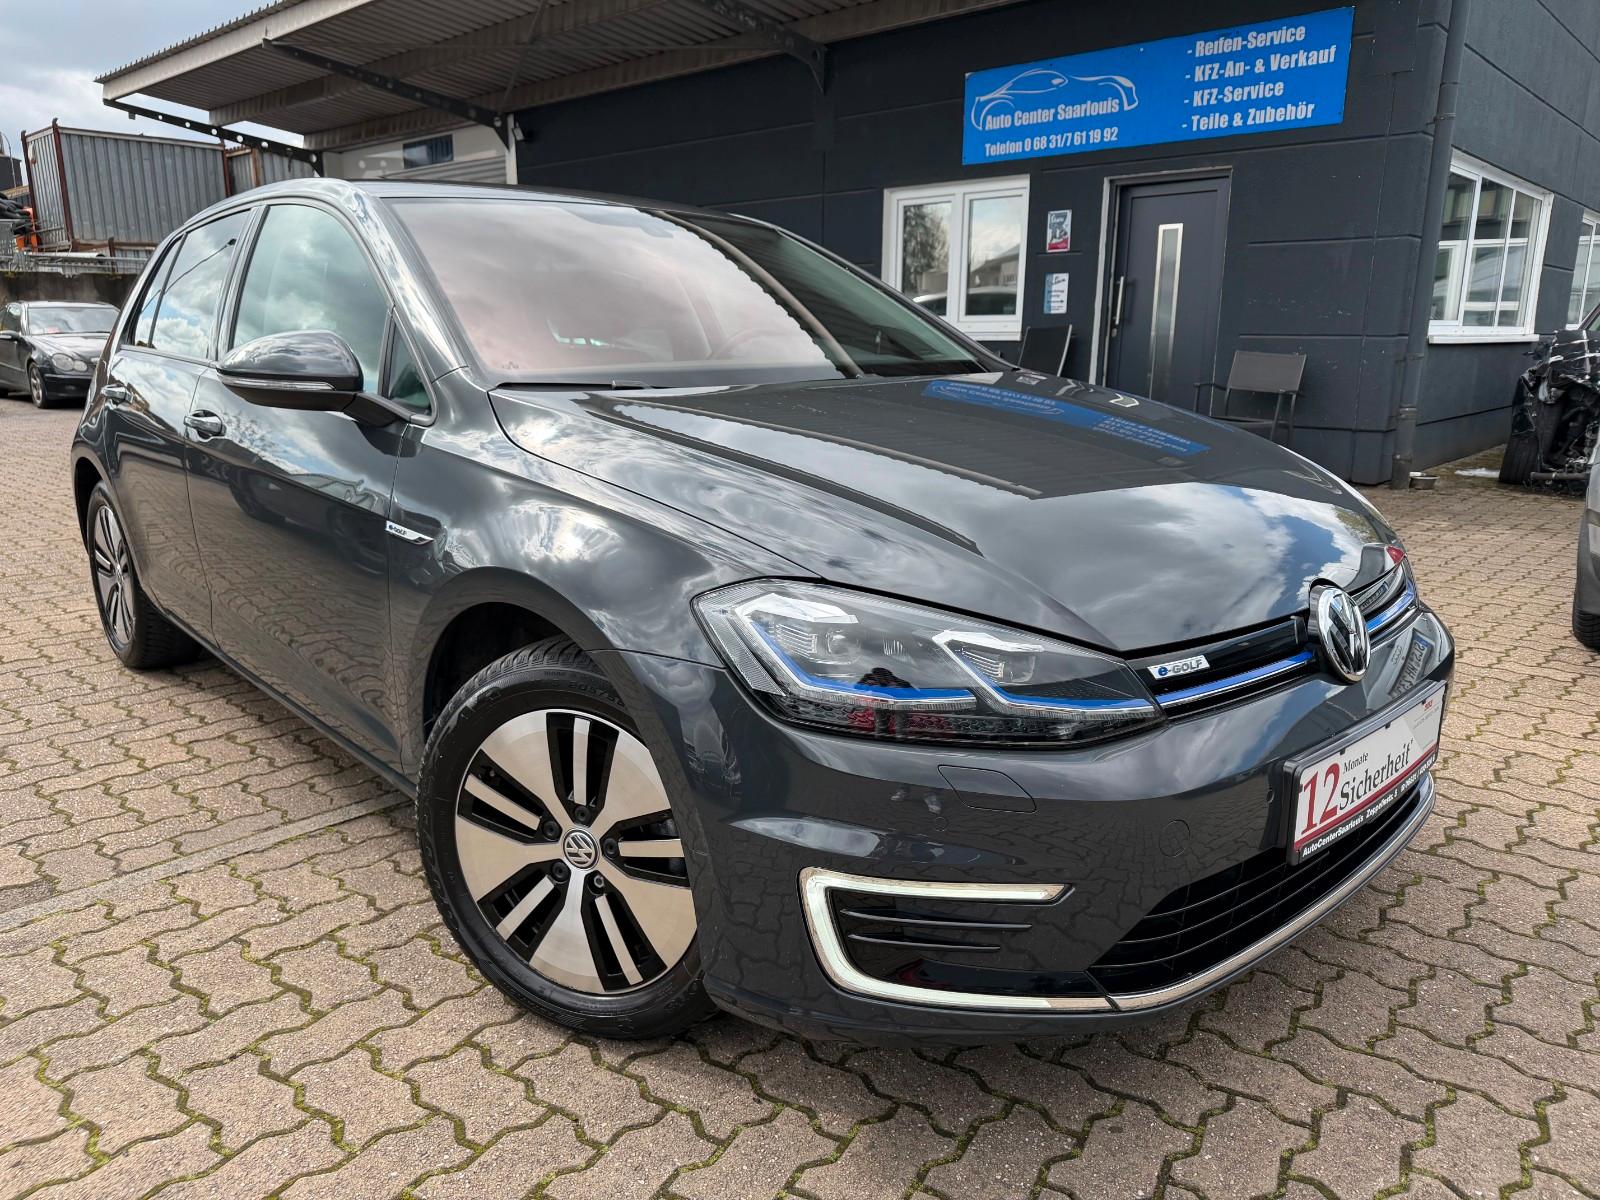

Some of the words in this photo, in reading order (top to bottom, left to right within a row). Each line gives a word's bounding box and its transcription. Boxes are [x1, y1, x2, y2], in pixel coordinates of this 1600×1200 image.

[1195, 25, 1306, 57] Reifen-Service
[1194, 60, 1250, 82] KFZ-An-
[1254, 58, 1265, 74] &
[1270, 45, 1337, 71] Verkauf
[1192, 81, 1285, 107] KFZ-Service
[985, 112, 1011, 131] Auto
[1013, 106, 1056, 125] Center
[1057, 96, 1120, 120] Saarlouis
[1191, 112, 1229, 132] Teile
[1232, 112, 1243, 128] &
[1246, 101, 1315, 126] Zubehör
[985, 139, 1023, 157] Telefon
[1024, 137, 1032, 151] 0
[1033, 135, 1047, 150] 68
[1049, 132, 1072, 148] 31/7
[1073, 130, 1087, 145] 61
[1088, 128, 1101, 143] 19
[1103, 126, 1119, 142] 92
[1157, 658, 1204, 677] e-GOLF
[1301, 762, 1341, 836] 12
[1343, 752, 1369, 775] Monate
